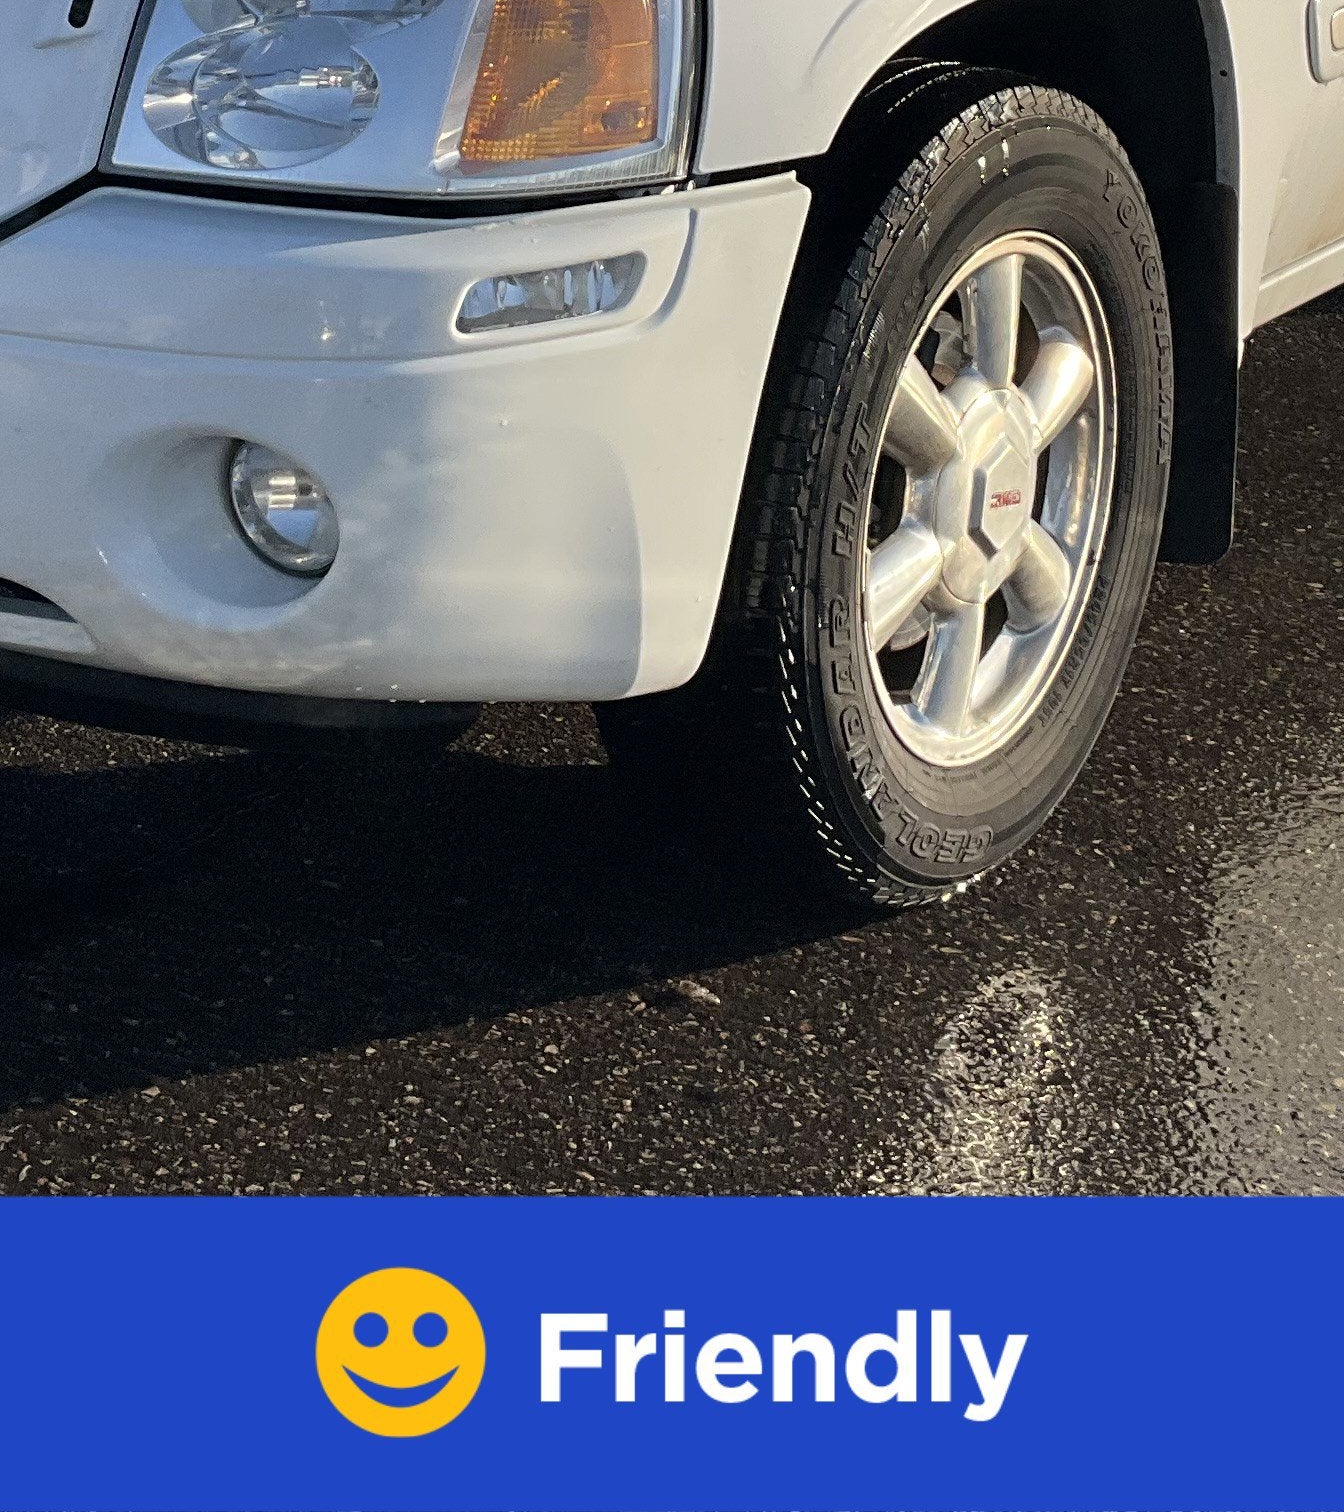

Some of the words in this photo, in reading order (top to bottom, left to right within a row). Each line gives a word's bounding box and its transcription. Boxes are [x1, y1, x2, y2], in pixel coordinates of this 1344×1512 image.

[1102, 168, 1173, 467] YOKOHAMA
[830, 399, 872, 560] H/T
[829, 594, 995, 864] GEOLANDAR
